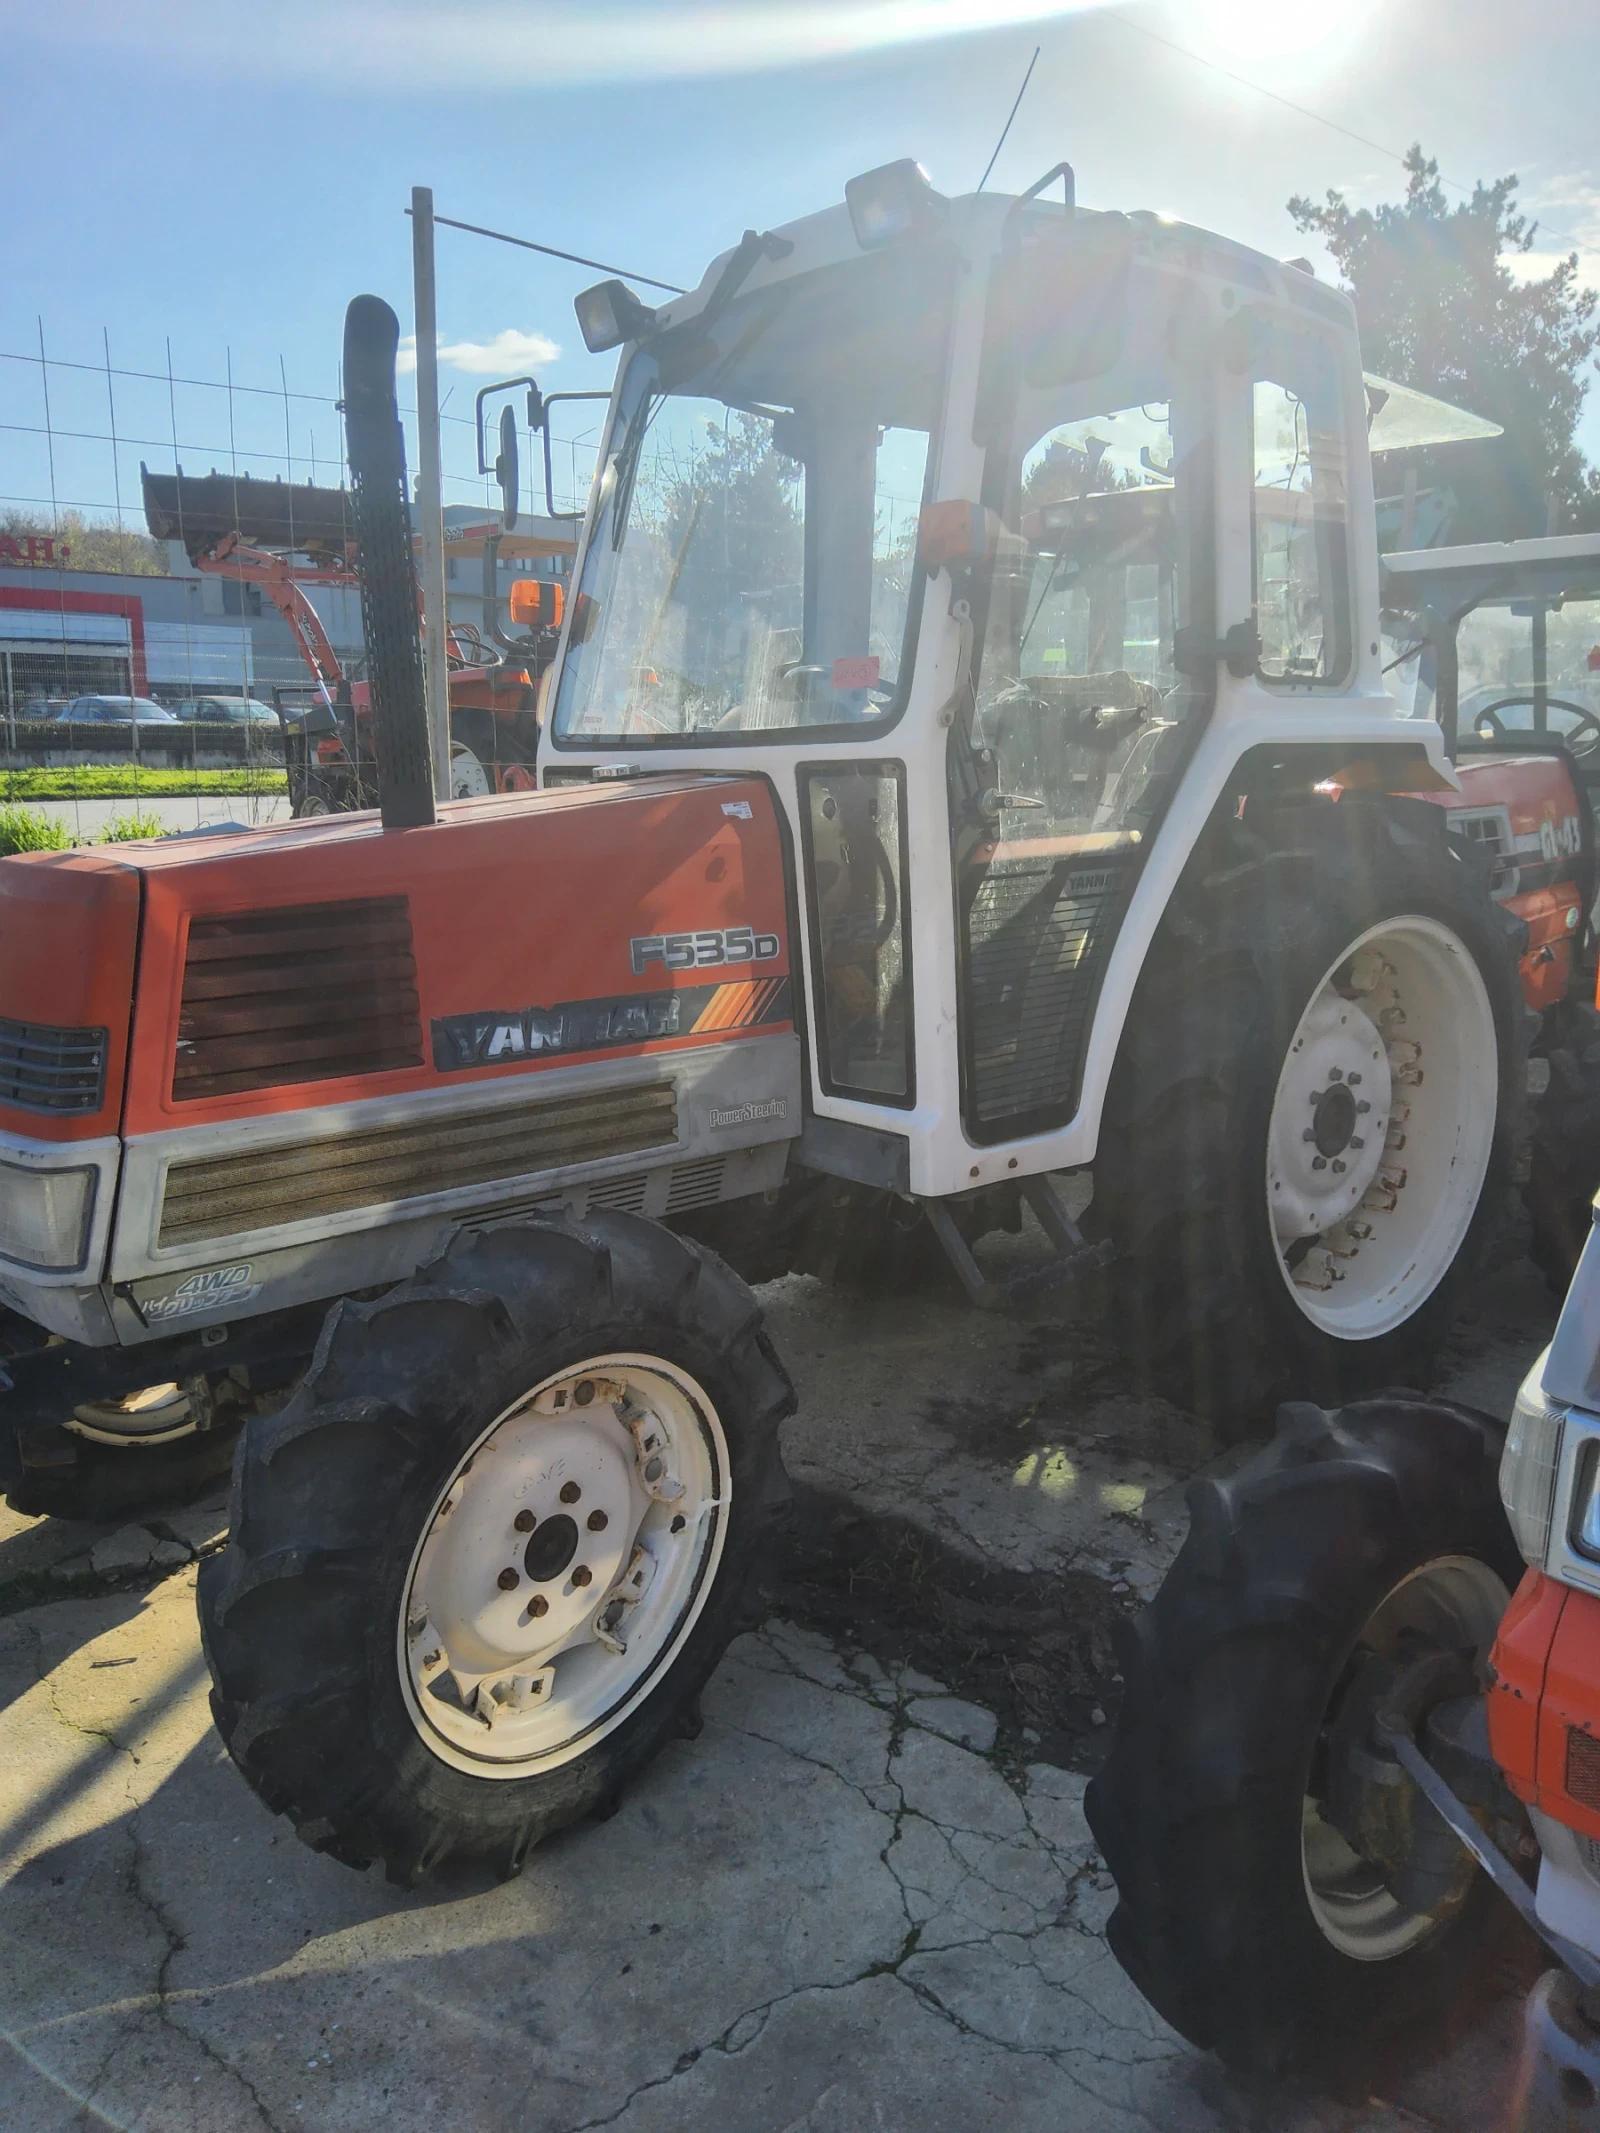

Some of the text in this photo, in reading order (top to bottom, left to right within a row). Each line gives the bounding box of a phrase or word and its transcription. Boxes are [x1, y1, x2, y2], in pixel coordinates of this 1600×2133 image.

[631, 925, 779, 974] F535D
[447, 995, 681, 1060] YANMAR
[175, 1264, 251, 1298] 4WD
